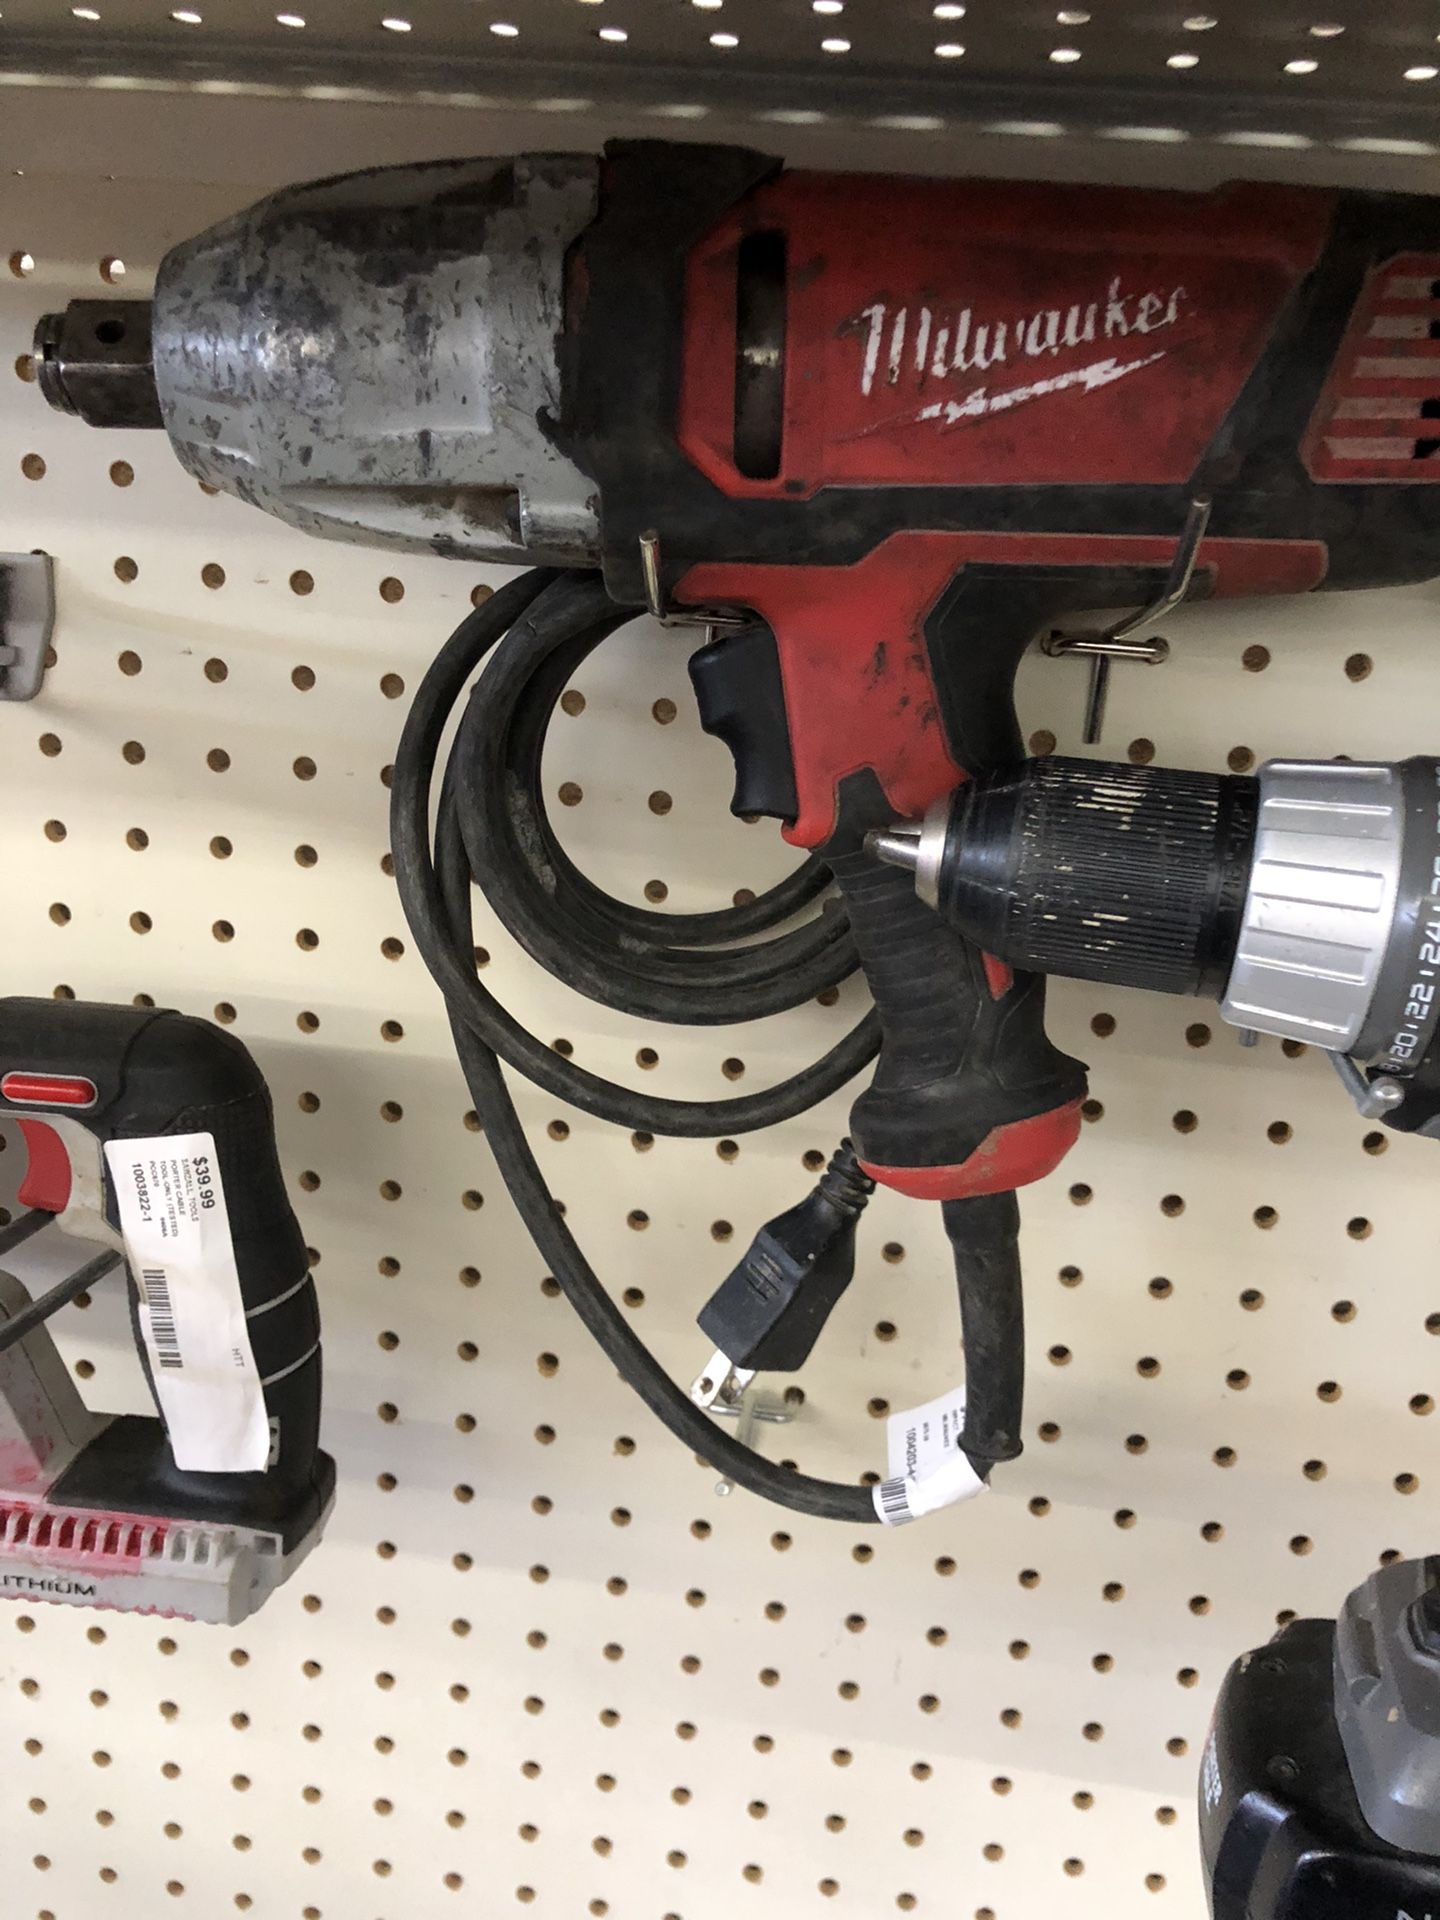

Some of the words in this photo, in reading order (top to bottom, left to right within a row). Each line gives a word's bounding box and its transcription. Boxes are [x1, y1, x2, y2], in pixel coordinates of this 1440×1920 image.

[1389, 1032, 1418, 1058] 20
[1404, 983, 1435, 1020] 22
[132, 1163, 153, 1222] 1003822-1
[170, 1159, 181, 1189] PORTER
[176, 1190, 187, 1216] CABLE
[189, 1197, 200, 1222] TOOLS
[192, 1156, 216, 1210] $39.99
[166, 1203, 179, 1237] (TESTED)
[0, 1575, 97, 1596] ITHIUM
